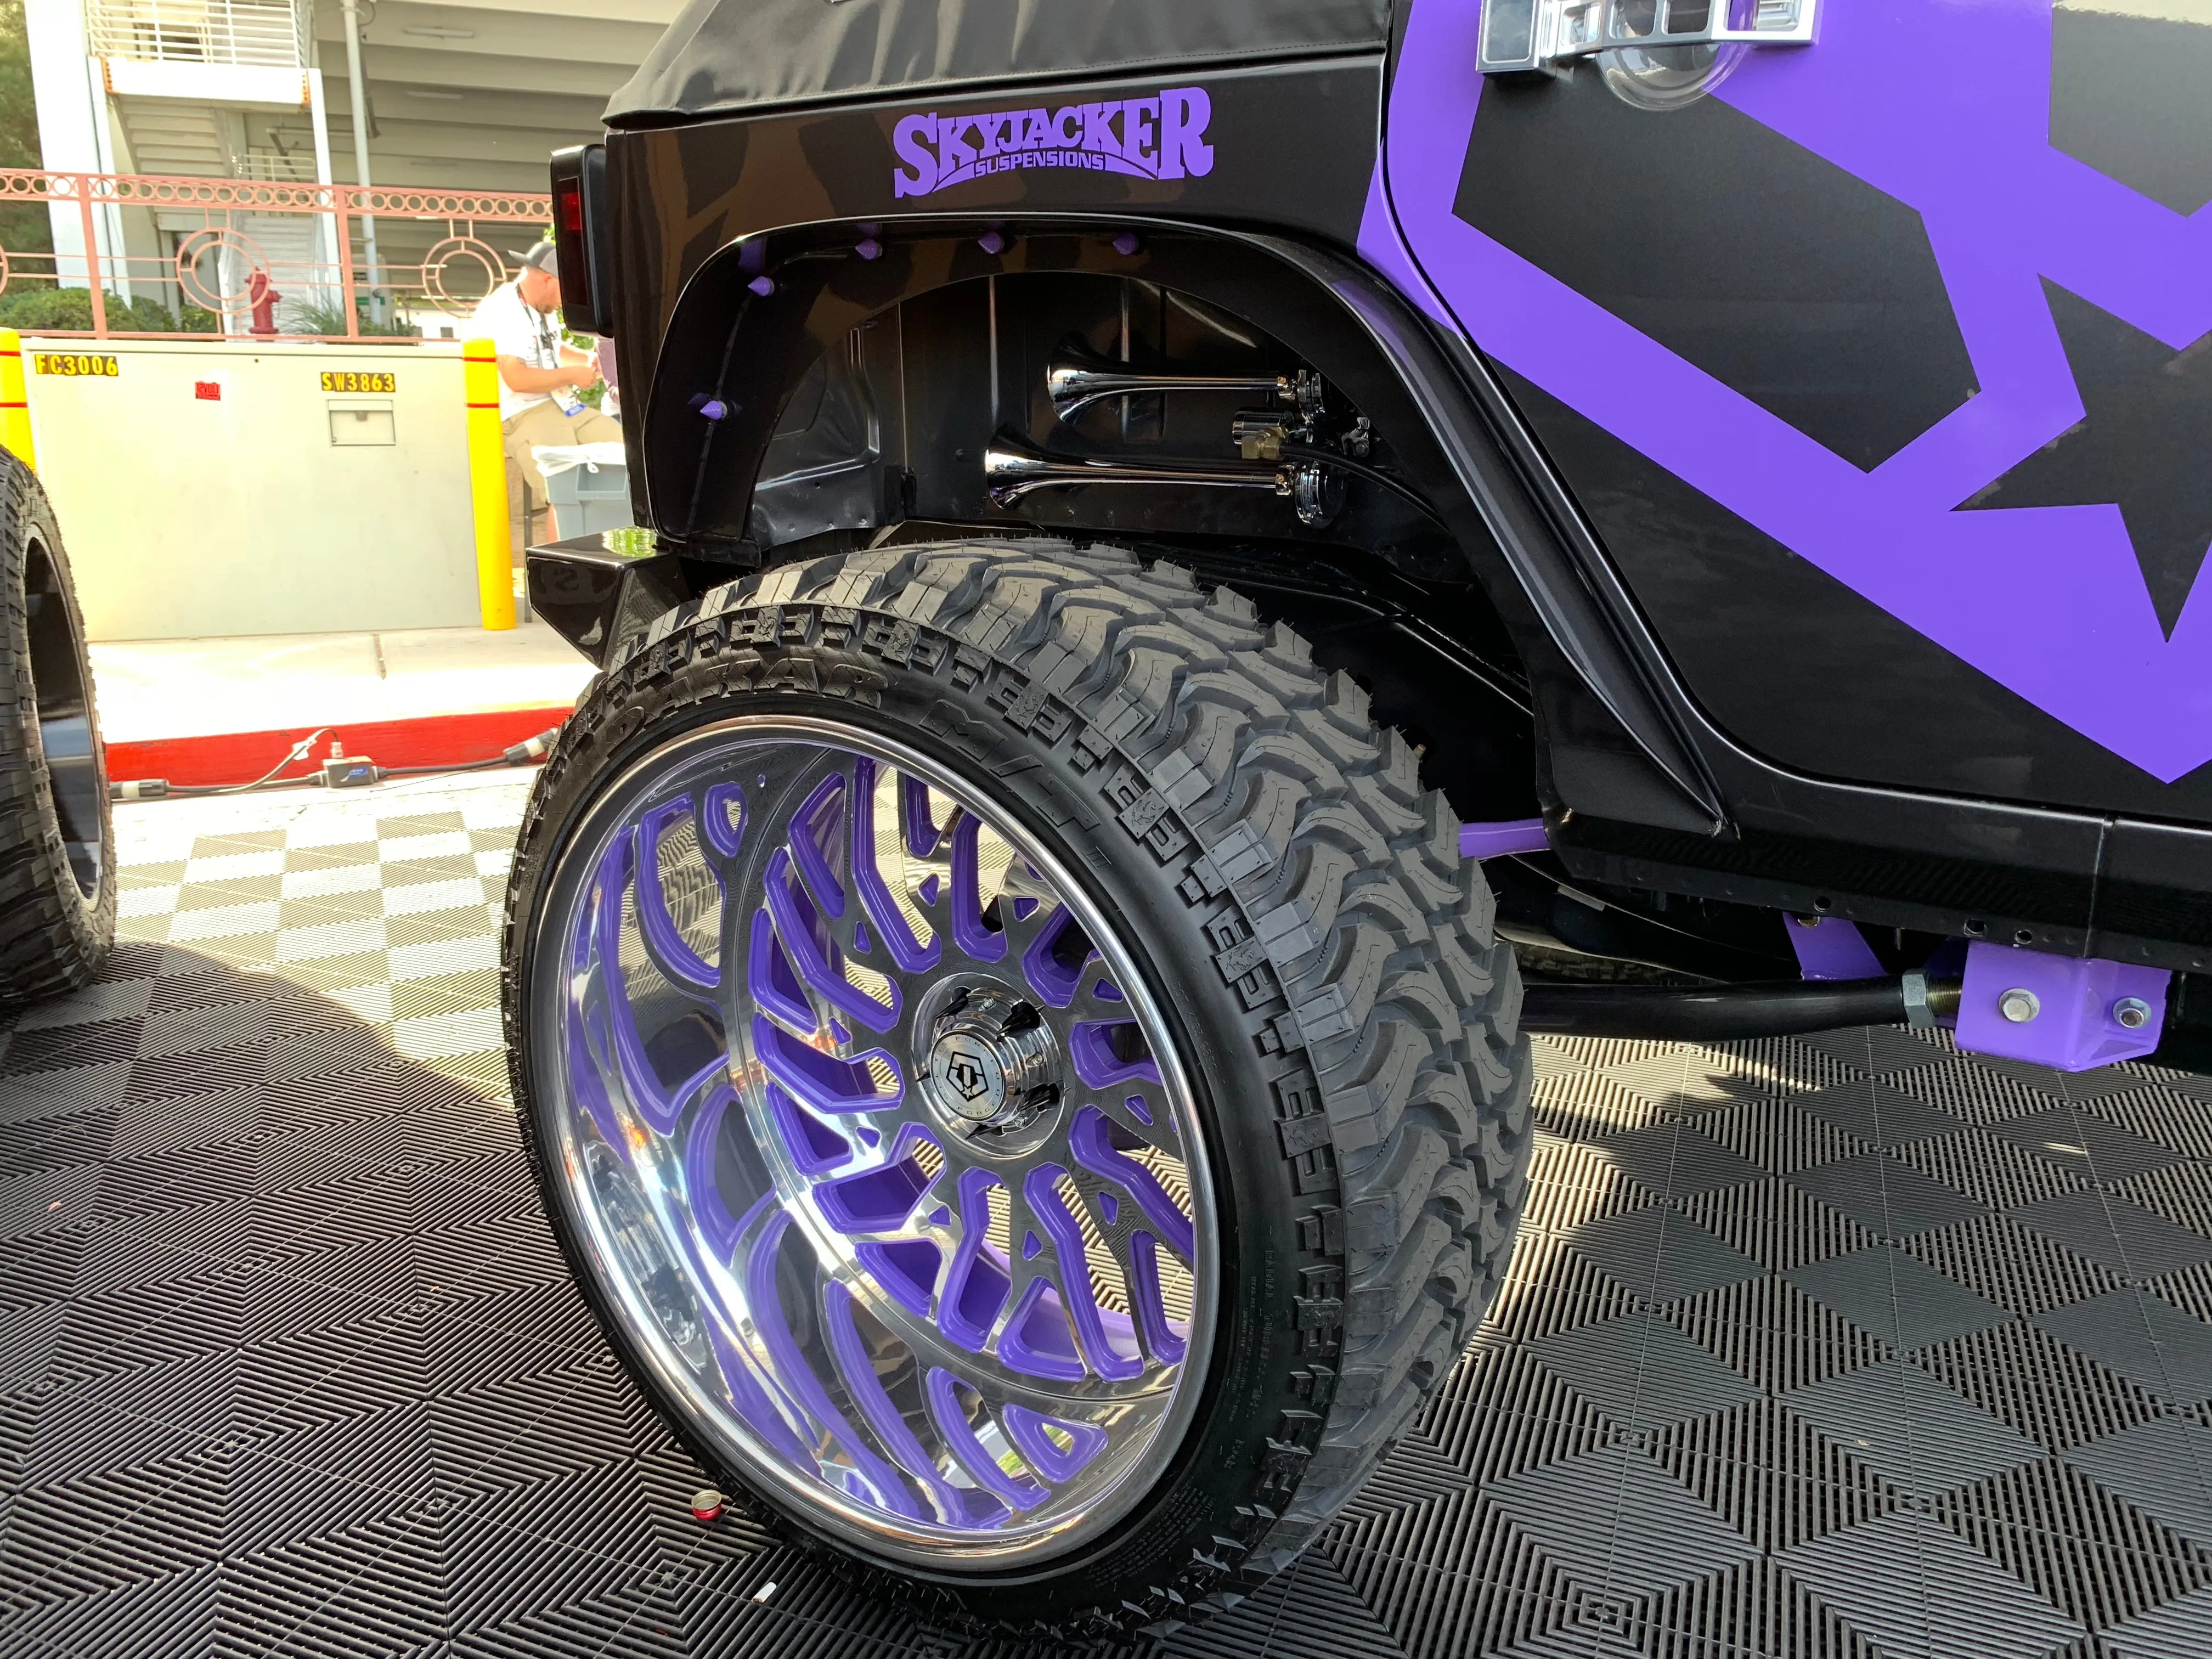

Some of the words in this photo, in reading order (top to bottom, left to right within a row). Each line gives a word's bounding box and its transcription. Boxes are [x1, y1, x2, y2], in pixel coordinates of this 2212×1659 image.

[893, 86, 1215, 199] SKYJACKER
[974, 150, 1106, 178] SUSPENSIONS
[35, 355, 119, 376] FC3006
[321, 373, 396, 392] SW3863
[606, 657, 889, 760] DAKAR
